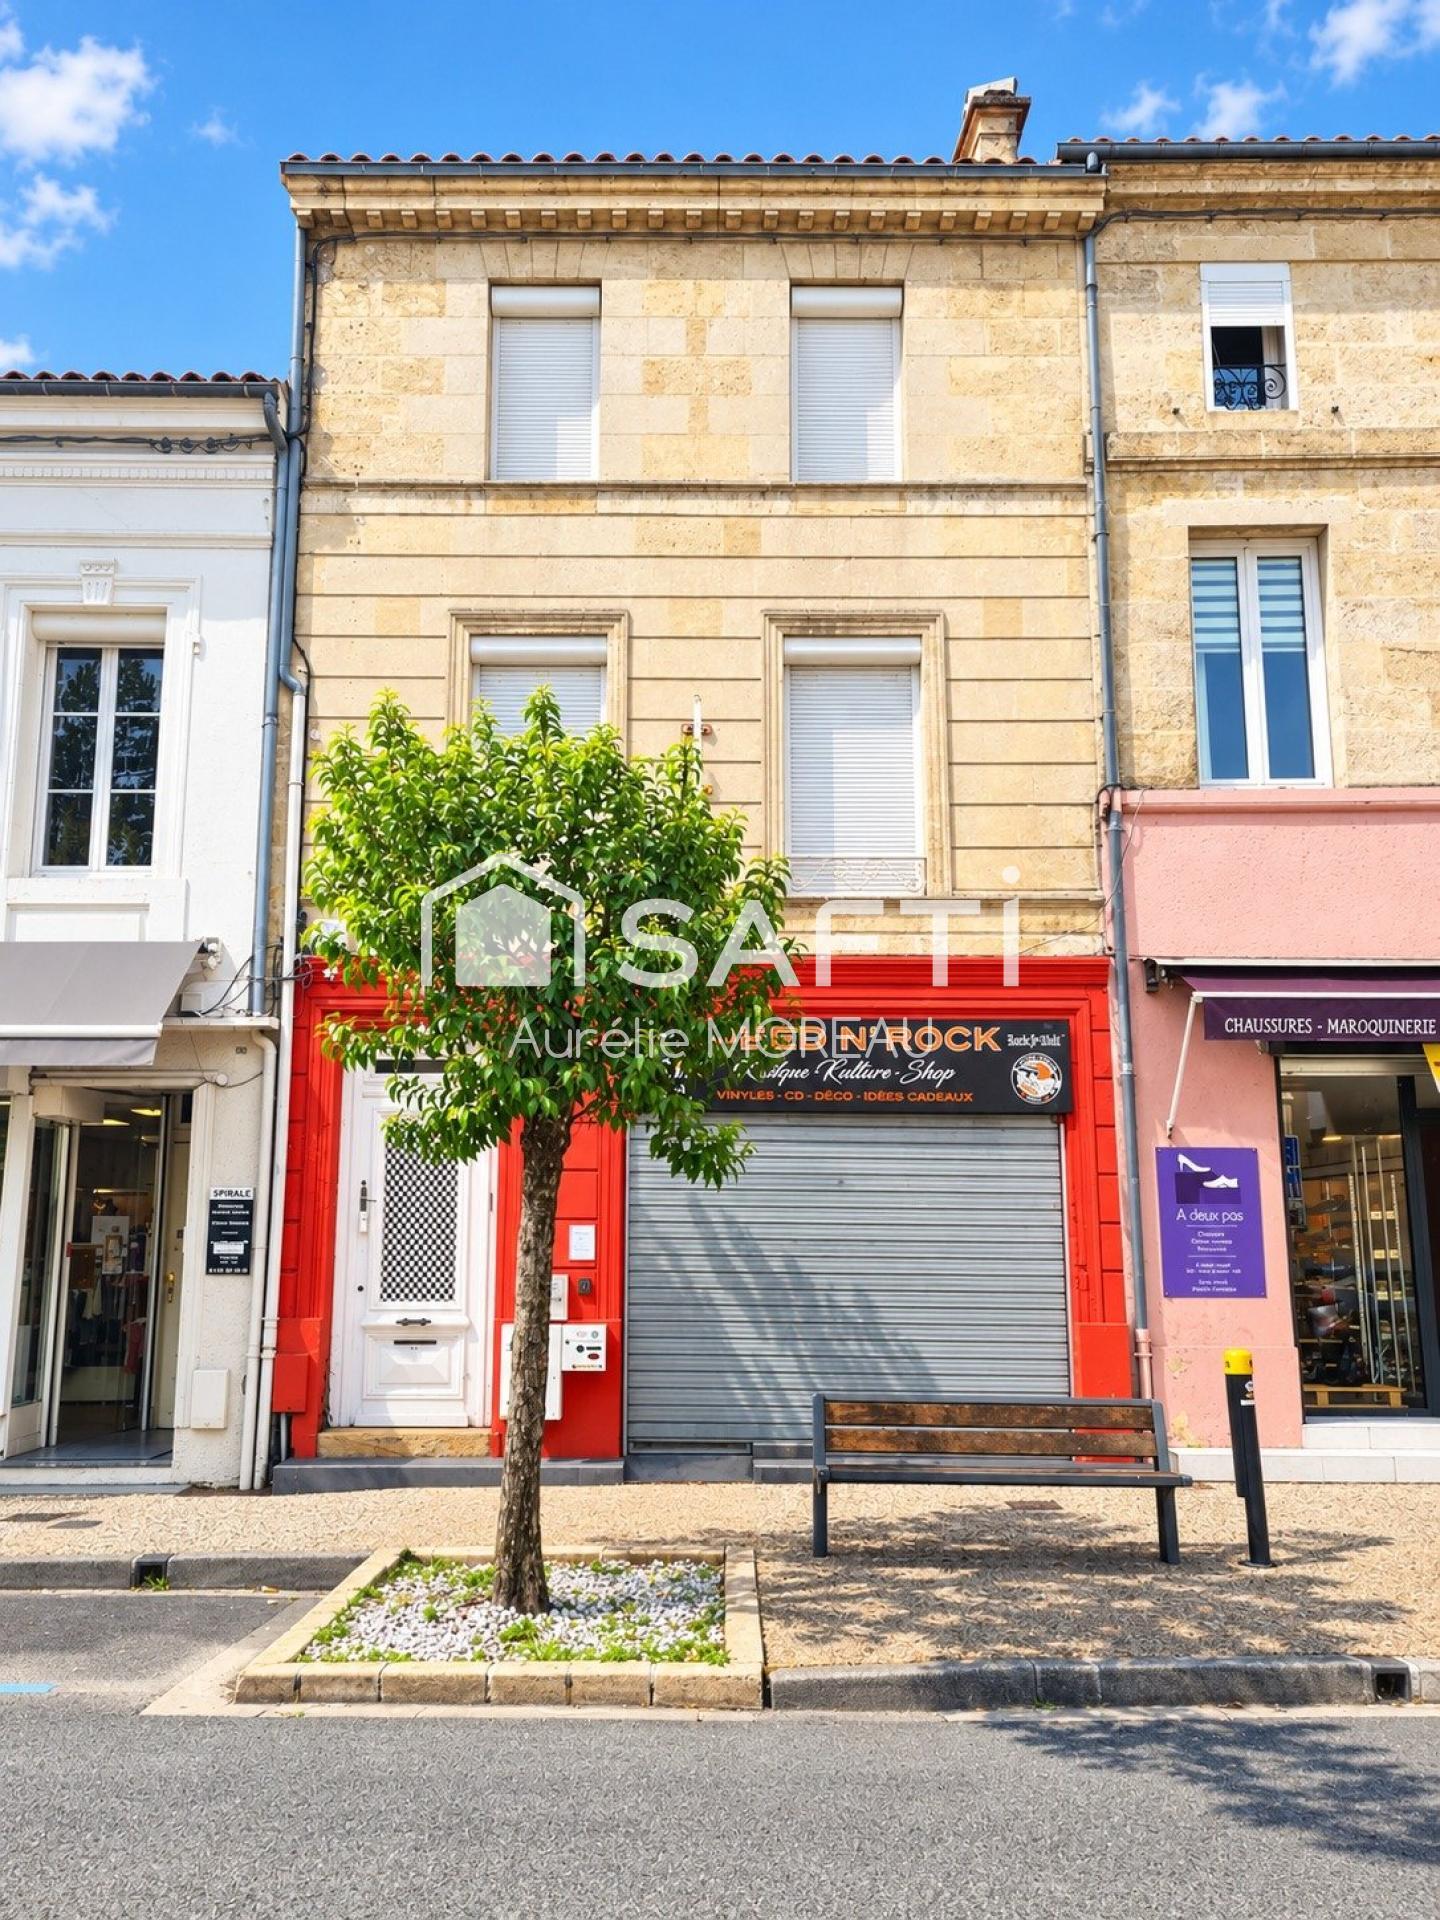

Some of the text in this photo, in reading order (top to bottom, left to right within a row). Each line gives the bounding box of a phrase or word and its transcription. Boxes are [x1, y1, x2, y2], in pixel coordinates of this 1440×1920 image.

[1224, 1017, 1313, 1034] CHAUSSURES
[1327, 1018, 1437, 1036] MAROQUINERIE
[899, 1058, 957, 1089] Shop
[716, 1089, 775, 1101] VINYLES
[784, 1090, 804, 1101] CD
[906, 1091, 974, 1103] CADEAUX
[213, 1189, 252, 1198] SPIRALE
[1189, 1208, 1219, 1222] deux
[1221, 1211, 1244, 1224] pas
